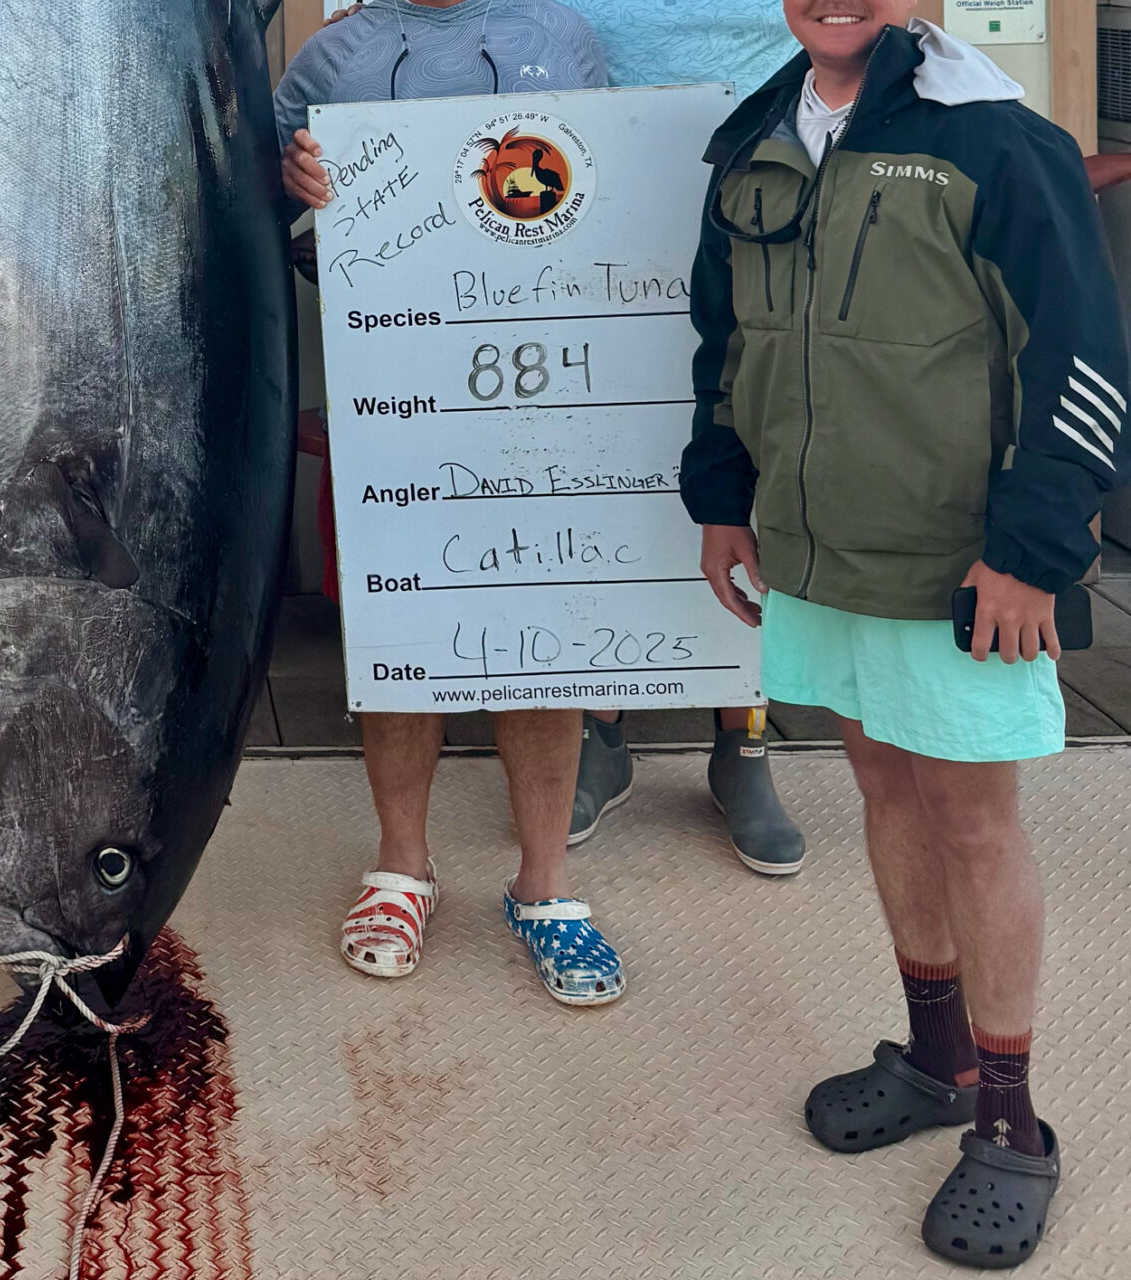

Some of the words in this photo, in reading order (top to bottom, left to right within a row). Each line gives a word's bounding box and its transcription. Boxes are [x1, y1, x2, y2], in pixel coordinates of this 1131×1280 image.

[984, 0, 1005, 8] Weigh
[317, 132, 404, 198] Pending
[584, 156, 593, 169] TX
[870, 161, 950, 186] SIMMS
[468, 196, 510, 236] Pelican
[514, 222, 545, 238] Rest
[543, 191, 586, 233] Marina
[479, 216, 578, 245] www.pelicanrestmarina.com
[329, 201, 456, 288] Record
[593, 262, 692, 305] Tuna
[347, 308, 442, 333] Species
[468, 342, 592, 402] 884
[353, 395, 437, 419] Weight
[361, 483, 441, 507] Angler
[442, 528, 642, 573] Catillac
[366, 573, 421, 593] Boat
[372, 662, 427, 681] Date
[432, 680, 685, 704] www.pelicanrestmarina.com
